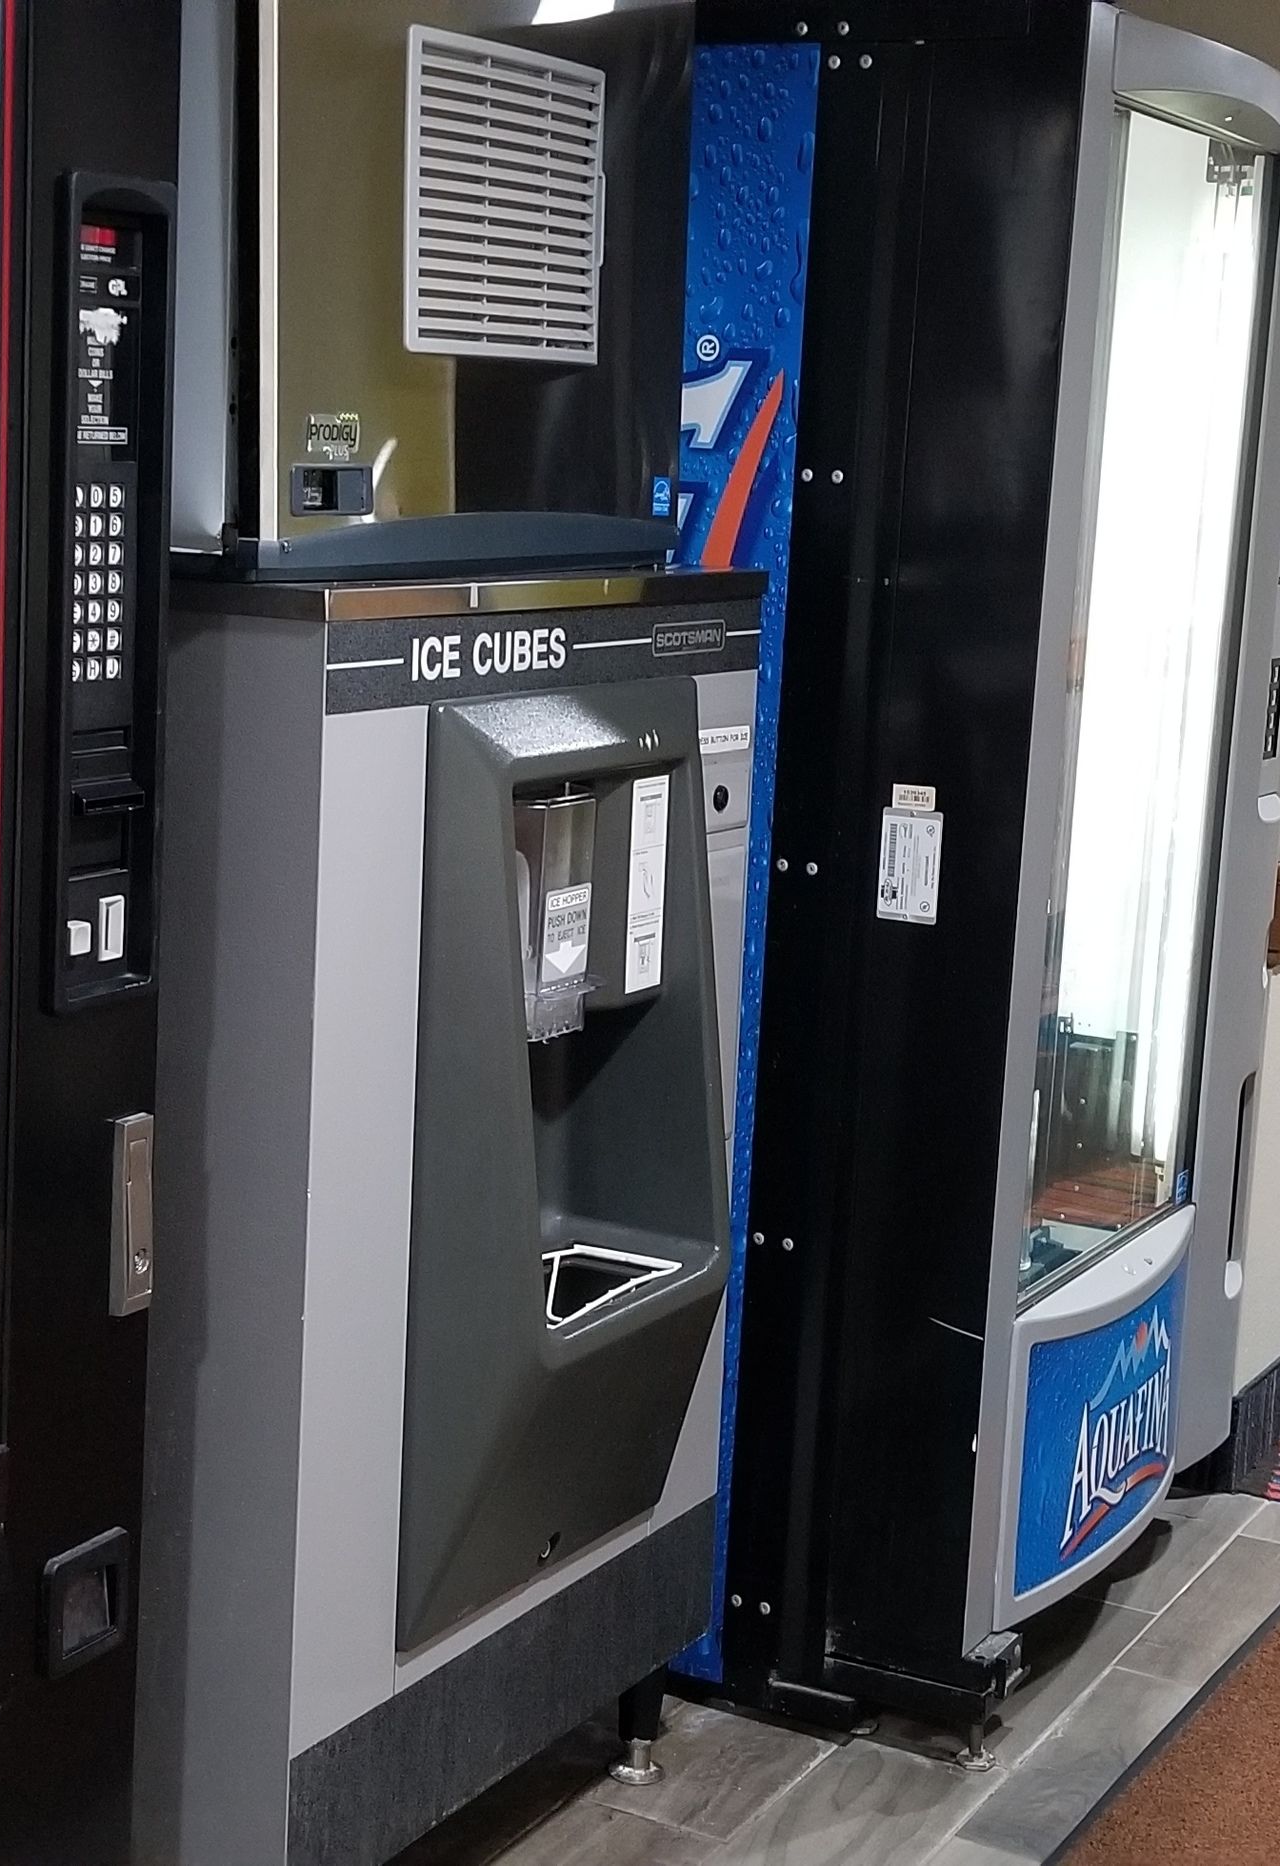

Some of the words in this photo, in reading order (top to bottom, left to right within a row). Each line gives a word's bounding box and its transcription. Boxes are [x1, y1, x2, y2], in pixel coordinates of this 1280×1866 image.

[656, 628, 721, 648] SCOTSMAN
[411, 635, 461, 681] ICE
[472, 627, 566, 676] CUBES
[711, 735, 729, 744] BUTTON
[730, 733, 739, 742] FOR
[550, 897, 561, 909] ICE
[562, 890, 587, 905] HOPPER
[548, 914, 566, 929] PUSH
[567, 909, 587, 925] DOWN
[558, 927, 574, 941] EJECT
[577, 924, 586, 935] ICE
[1059, 1340, 1172, 1550] AQUAFINA
